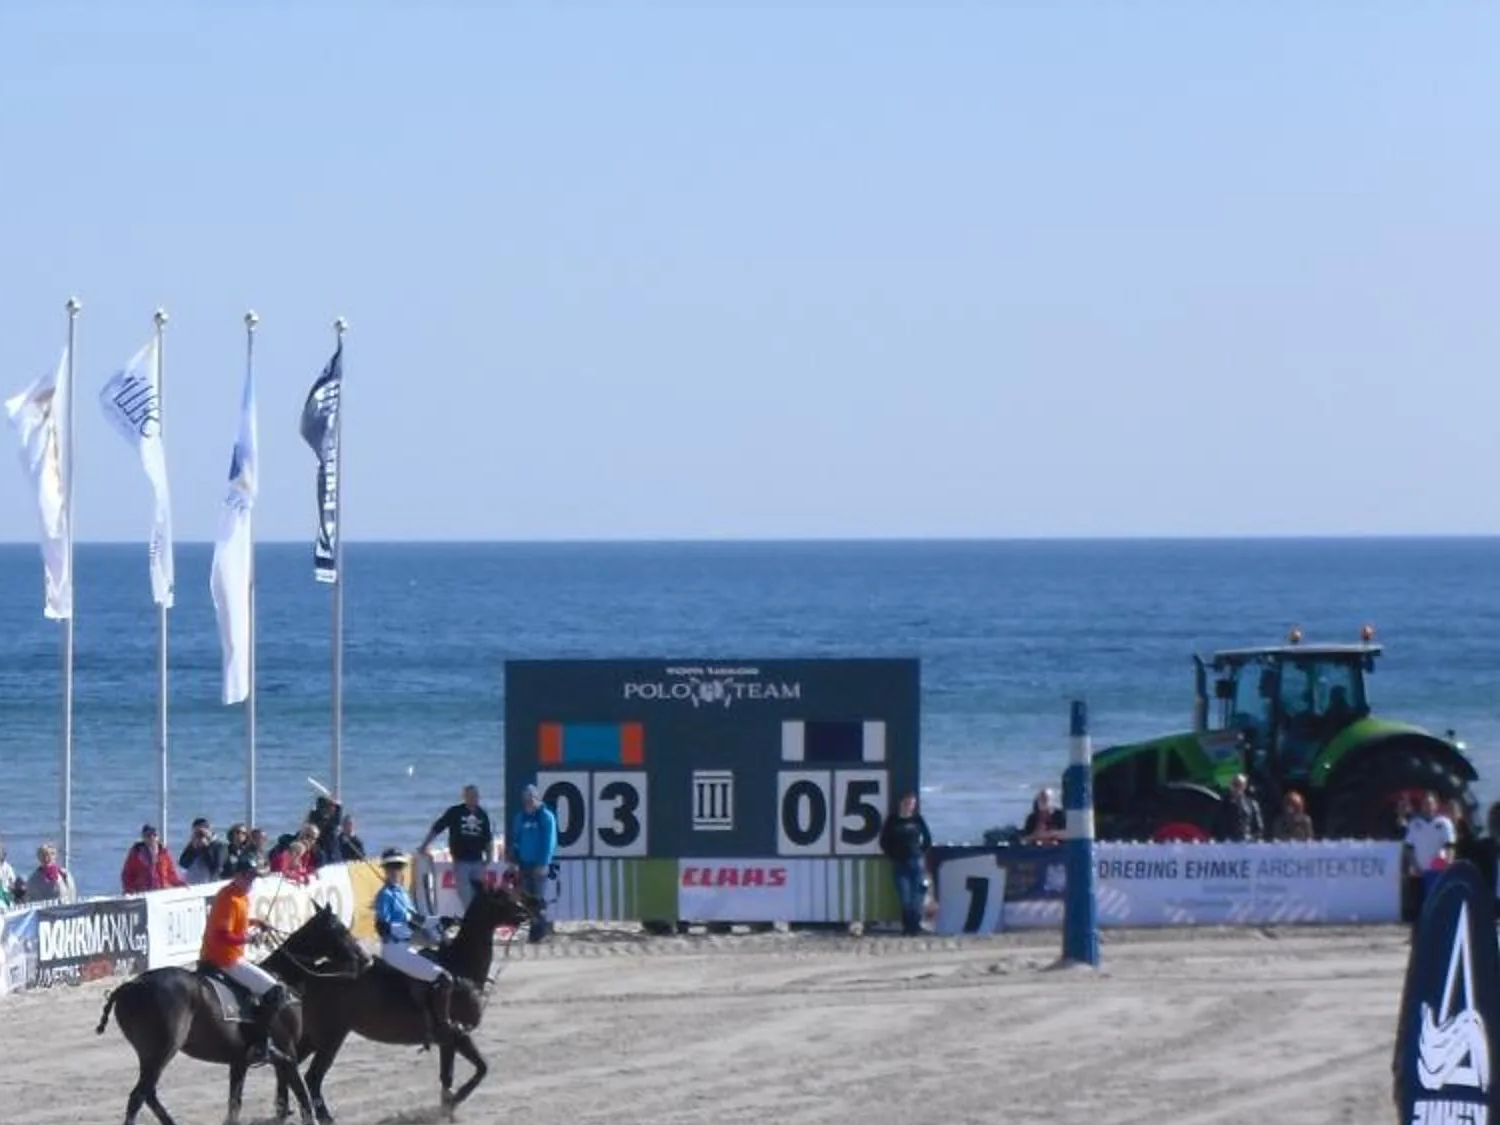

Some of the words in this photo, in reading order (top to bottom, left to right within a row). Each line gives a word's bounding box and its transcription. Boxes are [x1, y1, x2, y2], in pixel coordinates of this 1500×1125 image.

[624, 681, 691, 700] POLO
[733, 681, 802, 700] TEAM
[542, 780, 641, 848] 03
[782, 779, 882, 845] 05
[682, 867, 787, 887] CLAAS
[1185, 858, 1251, 879] EHMKE
[1256, 857, 1387, 879] ARCHITEKTEN
